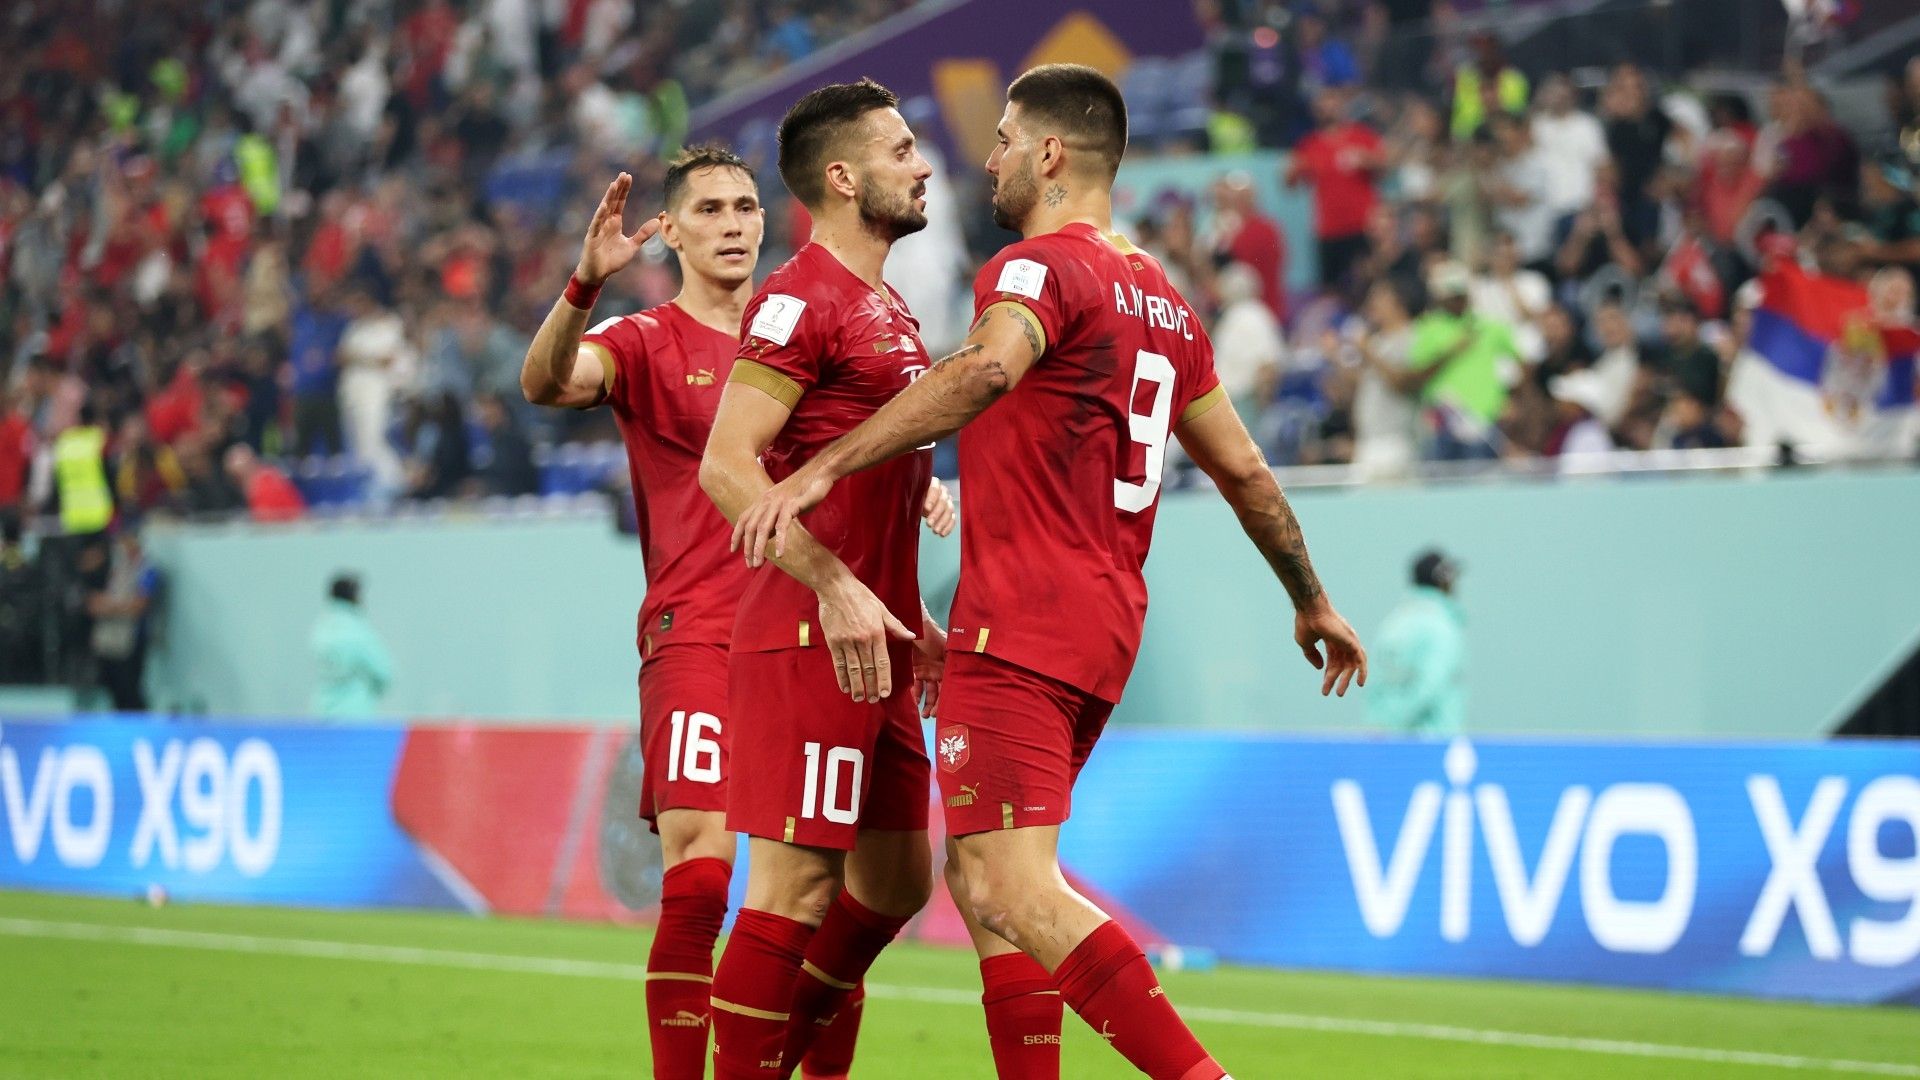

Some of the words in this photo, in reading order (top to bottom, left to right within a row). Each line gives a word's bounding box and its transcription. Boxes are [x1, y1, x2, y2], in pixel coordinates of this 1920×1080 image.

[1113, 348, 1176, 513] 9
[667, 711, 721, 783] 16
[801, 742, 864, 825] 10
[129, 737, 283, 877] X90
[660, 1018, 700, 1028] PUMA
